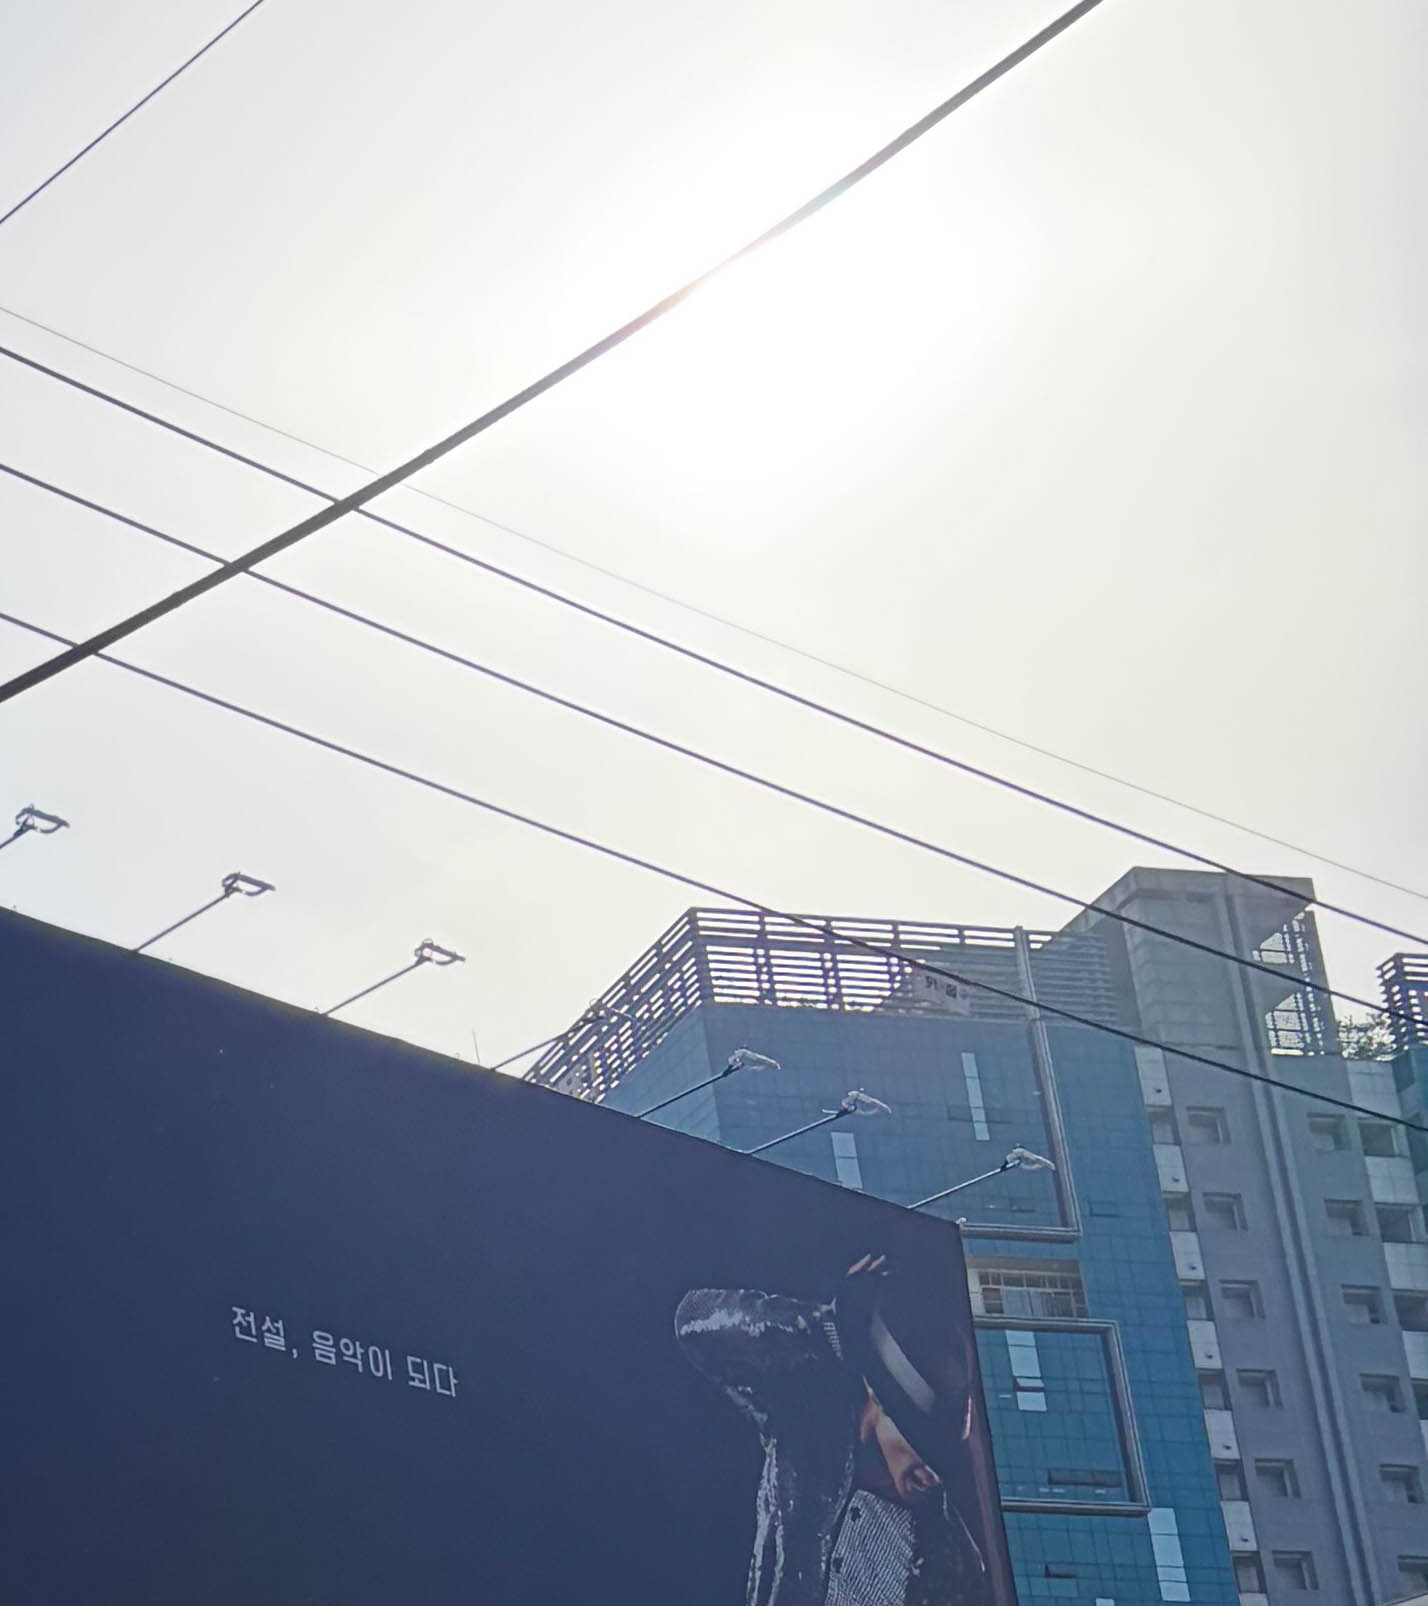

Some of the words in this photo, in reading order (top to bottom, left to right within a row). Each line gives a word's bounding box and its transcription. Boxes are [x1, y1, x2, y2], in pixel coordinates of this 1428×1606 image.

[231, 1305, 299, 1360] 전설,
[312, 1329, 393, 1381] 음악이
[405, 1354, 460, 1399] 되다
